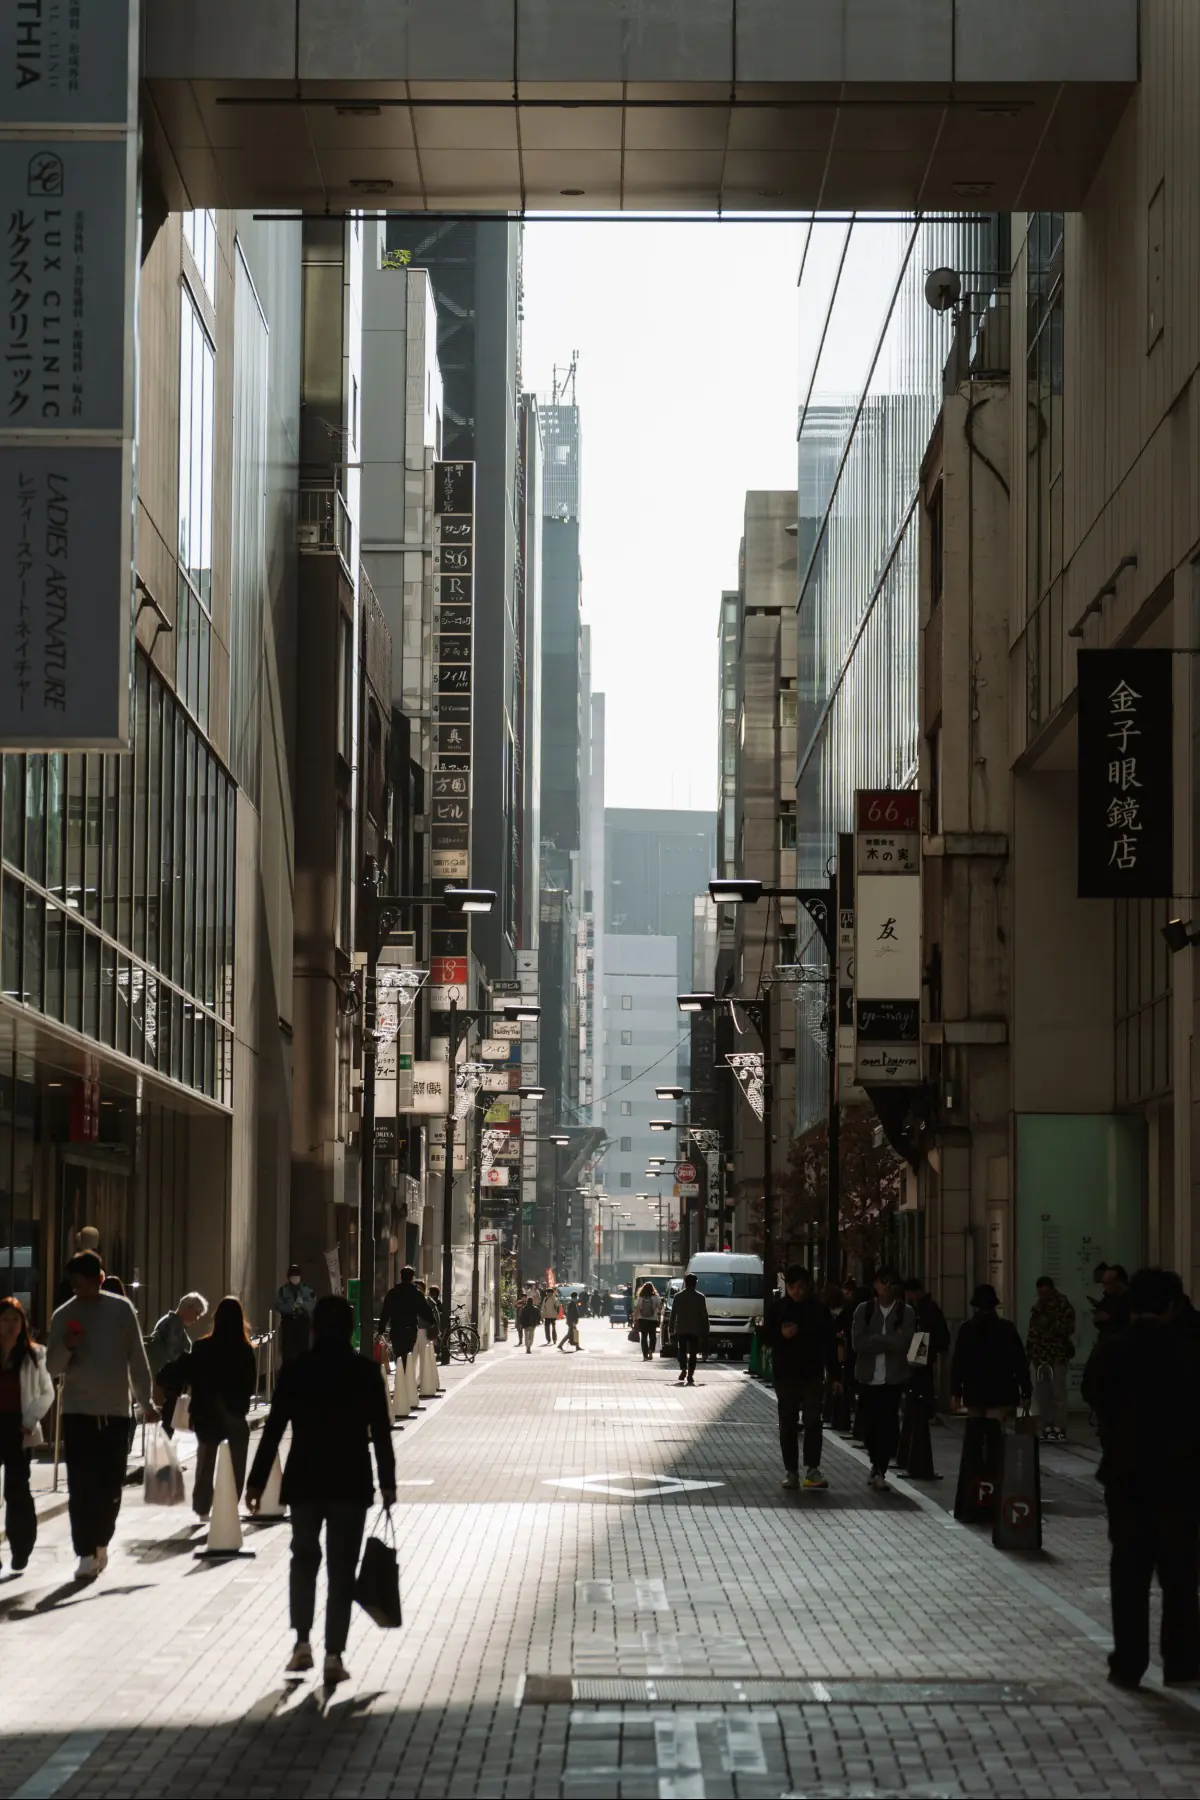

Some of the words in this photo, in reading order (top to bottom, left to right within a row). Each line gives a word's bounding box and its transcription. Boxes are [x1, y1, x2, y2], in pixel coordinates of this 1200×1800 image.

[43, 209, 61, 271] LUX
[5, 209, 35, 418] ルクスクリニック
[42, 290, 60, 418] CLINIC
[46, 472, 69, 560] LADIES
[14, 471, 37, 712] レディースアートネイチャー
[449, 578, 465, 594] R
[43, 563, 67, 713] ARTNATURE
[433, 675, 439, 683] 5
[446, 728, 463, 744] 真
[1106, 679, 1144, 870] 金子眼鏡店
[437, 803, 463, 819] ビル
[867, 799, 899, 822] 66
[867, 848, 909, 861] 木の実
[876, 917, 899, 941] 友
